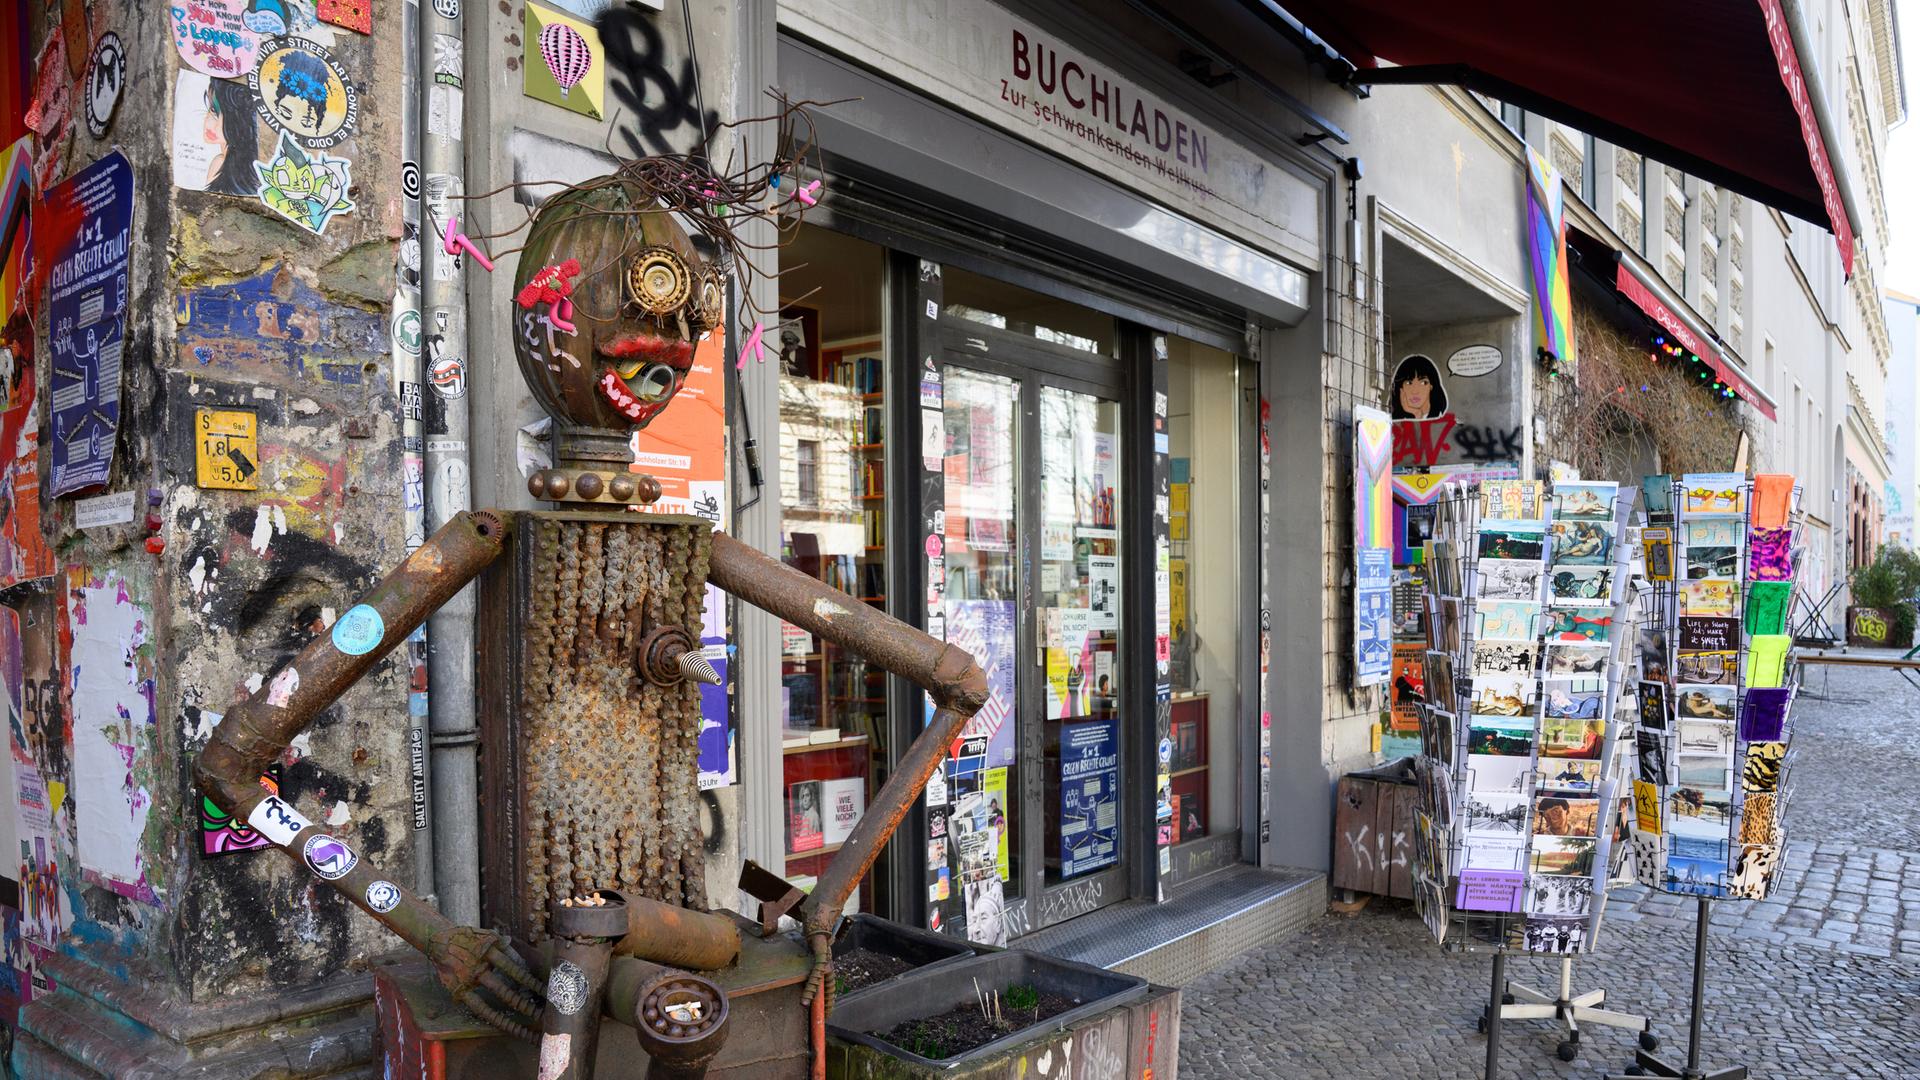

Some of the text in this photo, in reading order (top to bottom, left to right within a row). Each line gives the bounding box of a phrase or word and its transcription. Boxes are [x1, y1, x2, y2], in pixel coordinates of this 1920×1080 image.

[216, 10, 241, 22] KNOW
[288, 37, 330, 59] STREET
[331, 60, 349, 82] ART
[252, 94, 261, 102] Y
[1012, 29, 1208, 174] BUCHLADEN
[345, 86, 356, 130] CONTRA
[257, 104, 280, 131] VIVE
[1001, 78, 1026, 109] Zur
[1034, 100, 1151, 170] schwankenden
[307, 138, 334, 148] ODIO
[333, 129, 347, 141] EL
[202, 414, 210, 430] S
[203, 439, 225, 458] 1,8
[221, 466, 246, 484] 5,0
[412, 741, 426, 828] SALT CITY ANTIFA
[836, 803, 854, 813] VIELE
[838, 795, 851, 805] WIE
[835, 811, 857, 822] NOCH?
